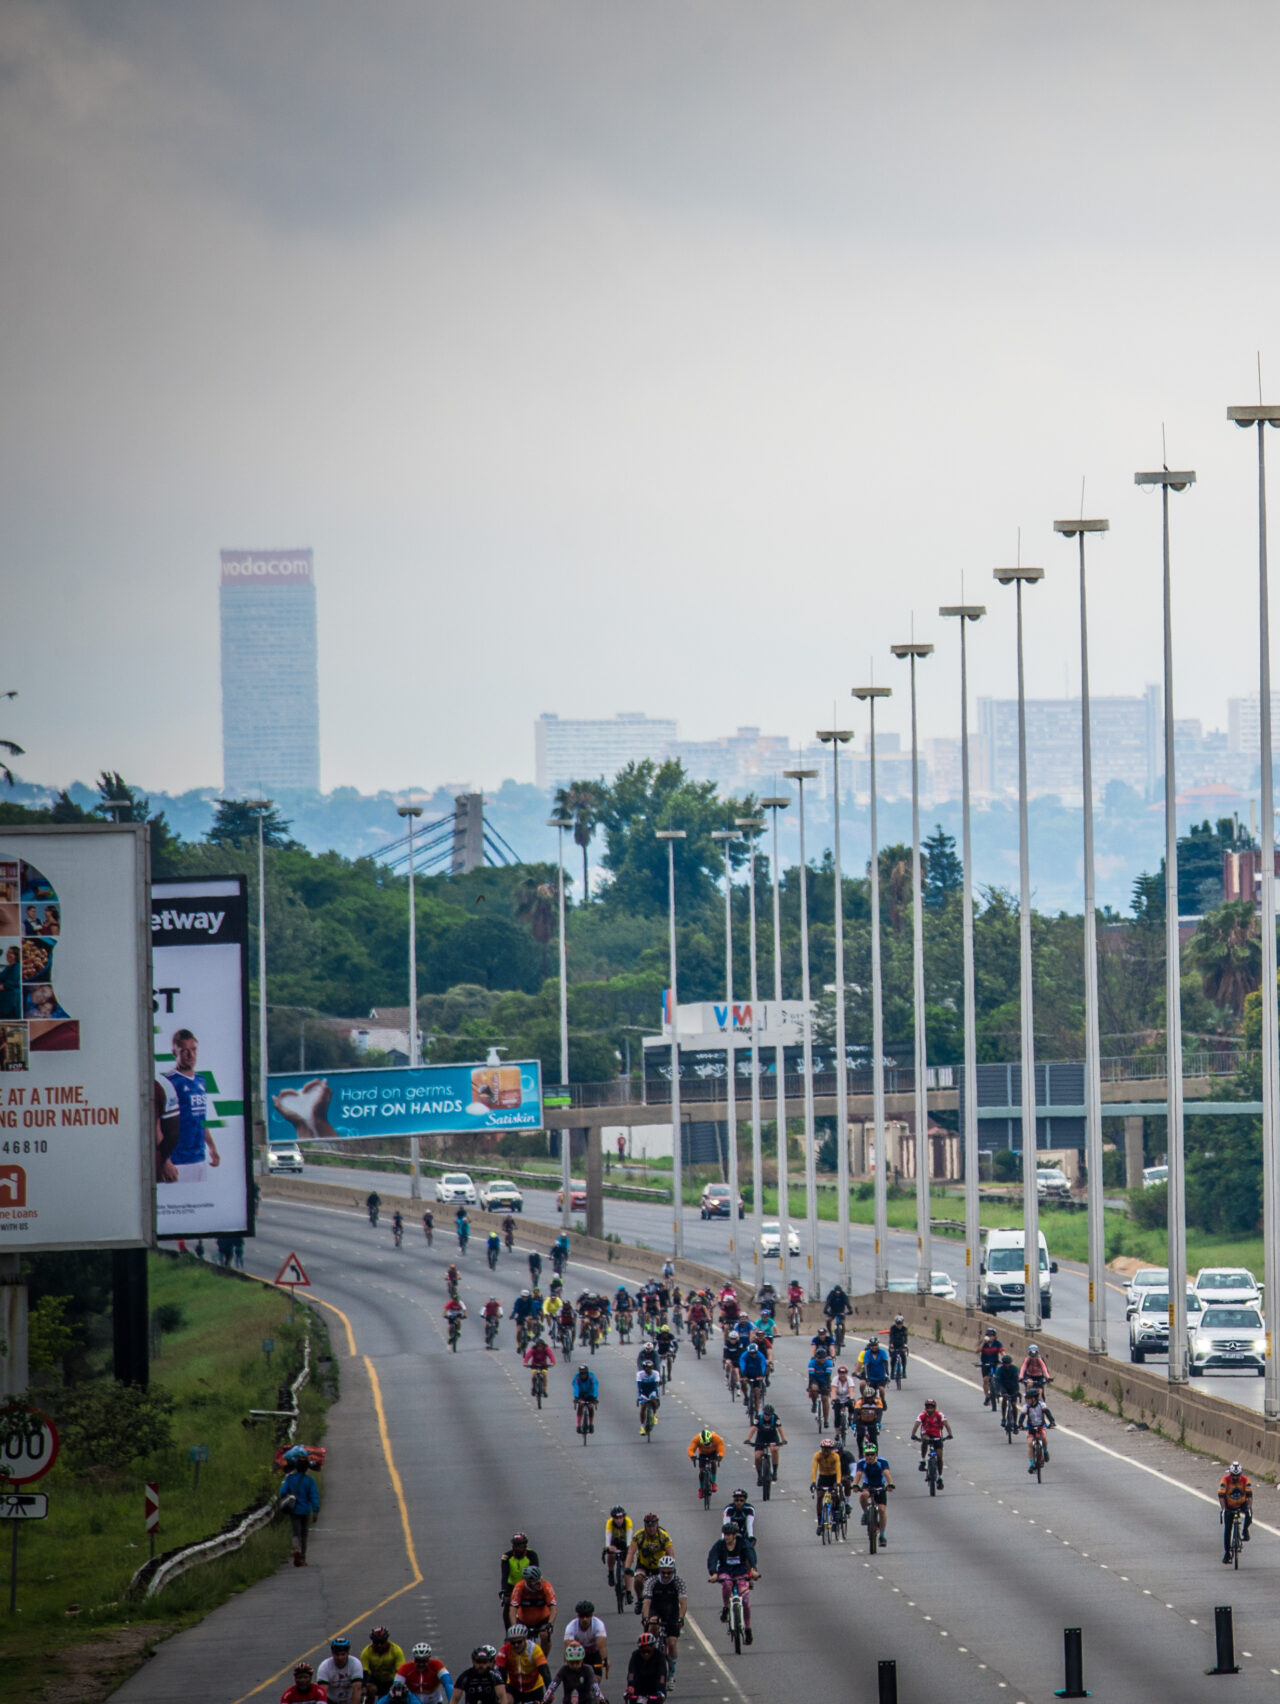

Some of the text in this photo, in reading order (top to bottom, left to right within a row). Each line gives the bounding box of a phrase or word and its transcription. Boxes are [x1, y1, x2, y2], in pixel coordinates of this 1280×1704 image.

[223, 557, 309, 576] vodacom
[8, 1088, 26, 1106] AT
[31, 1087, 41, 1105] A
[45, 1086, 89, 1105] TIME,
[341, 1087, 378, 1101] Hard
[382, 1087, 400, 1099] on
[23, 1109, 57, 1128] OUR
[61, 1107, 120, 1126] NATION
[342, 1100, 463, 1119] SOFT ON HANDS
[485, 1112, 536, 1126] Satiskin
[12, 1209, 39, 1219] Loans
[1, 1222, 29, 1231] WITH US
